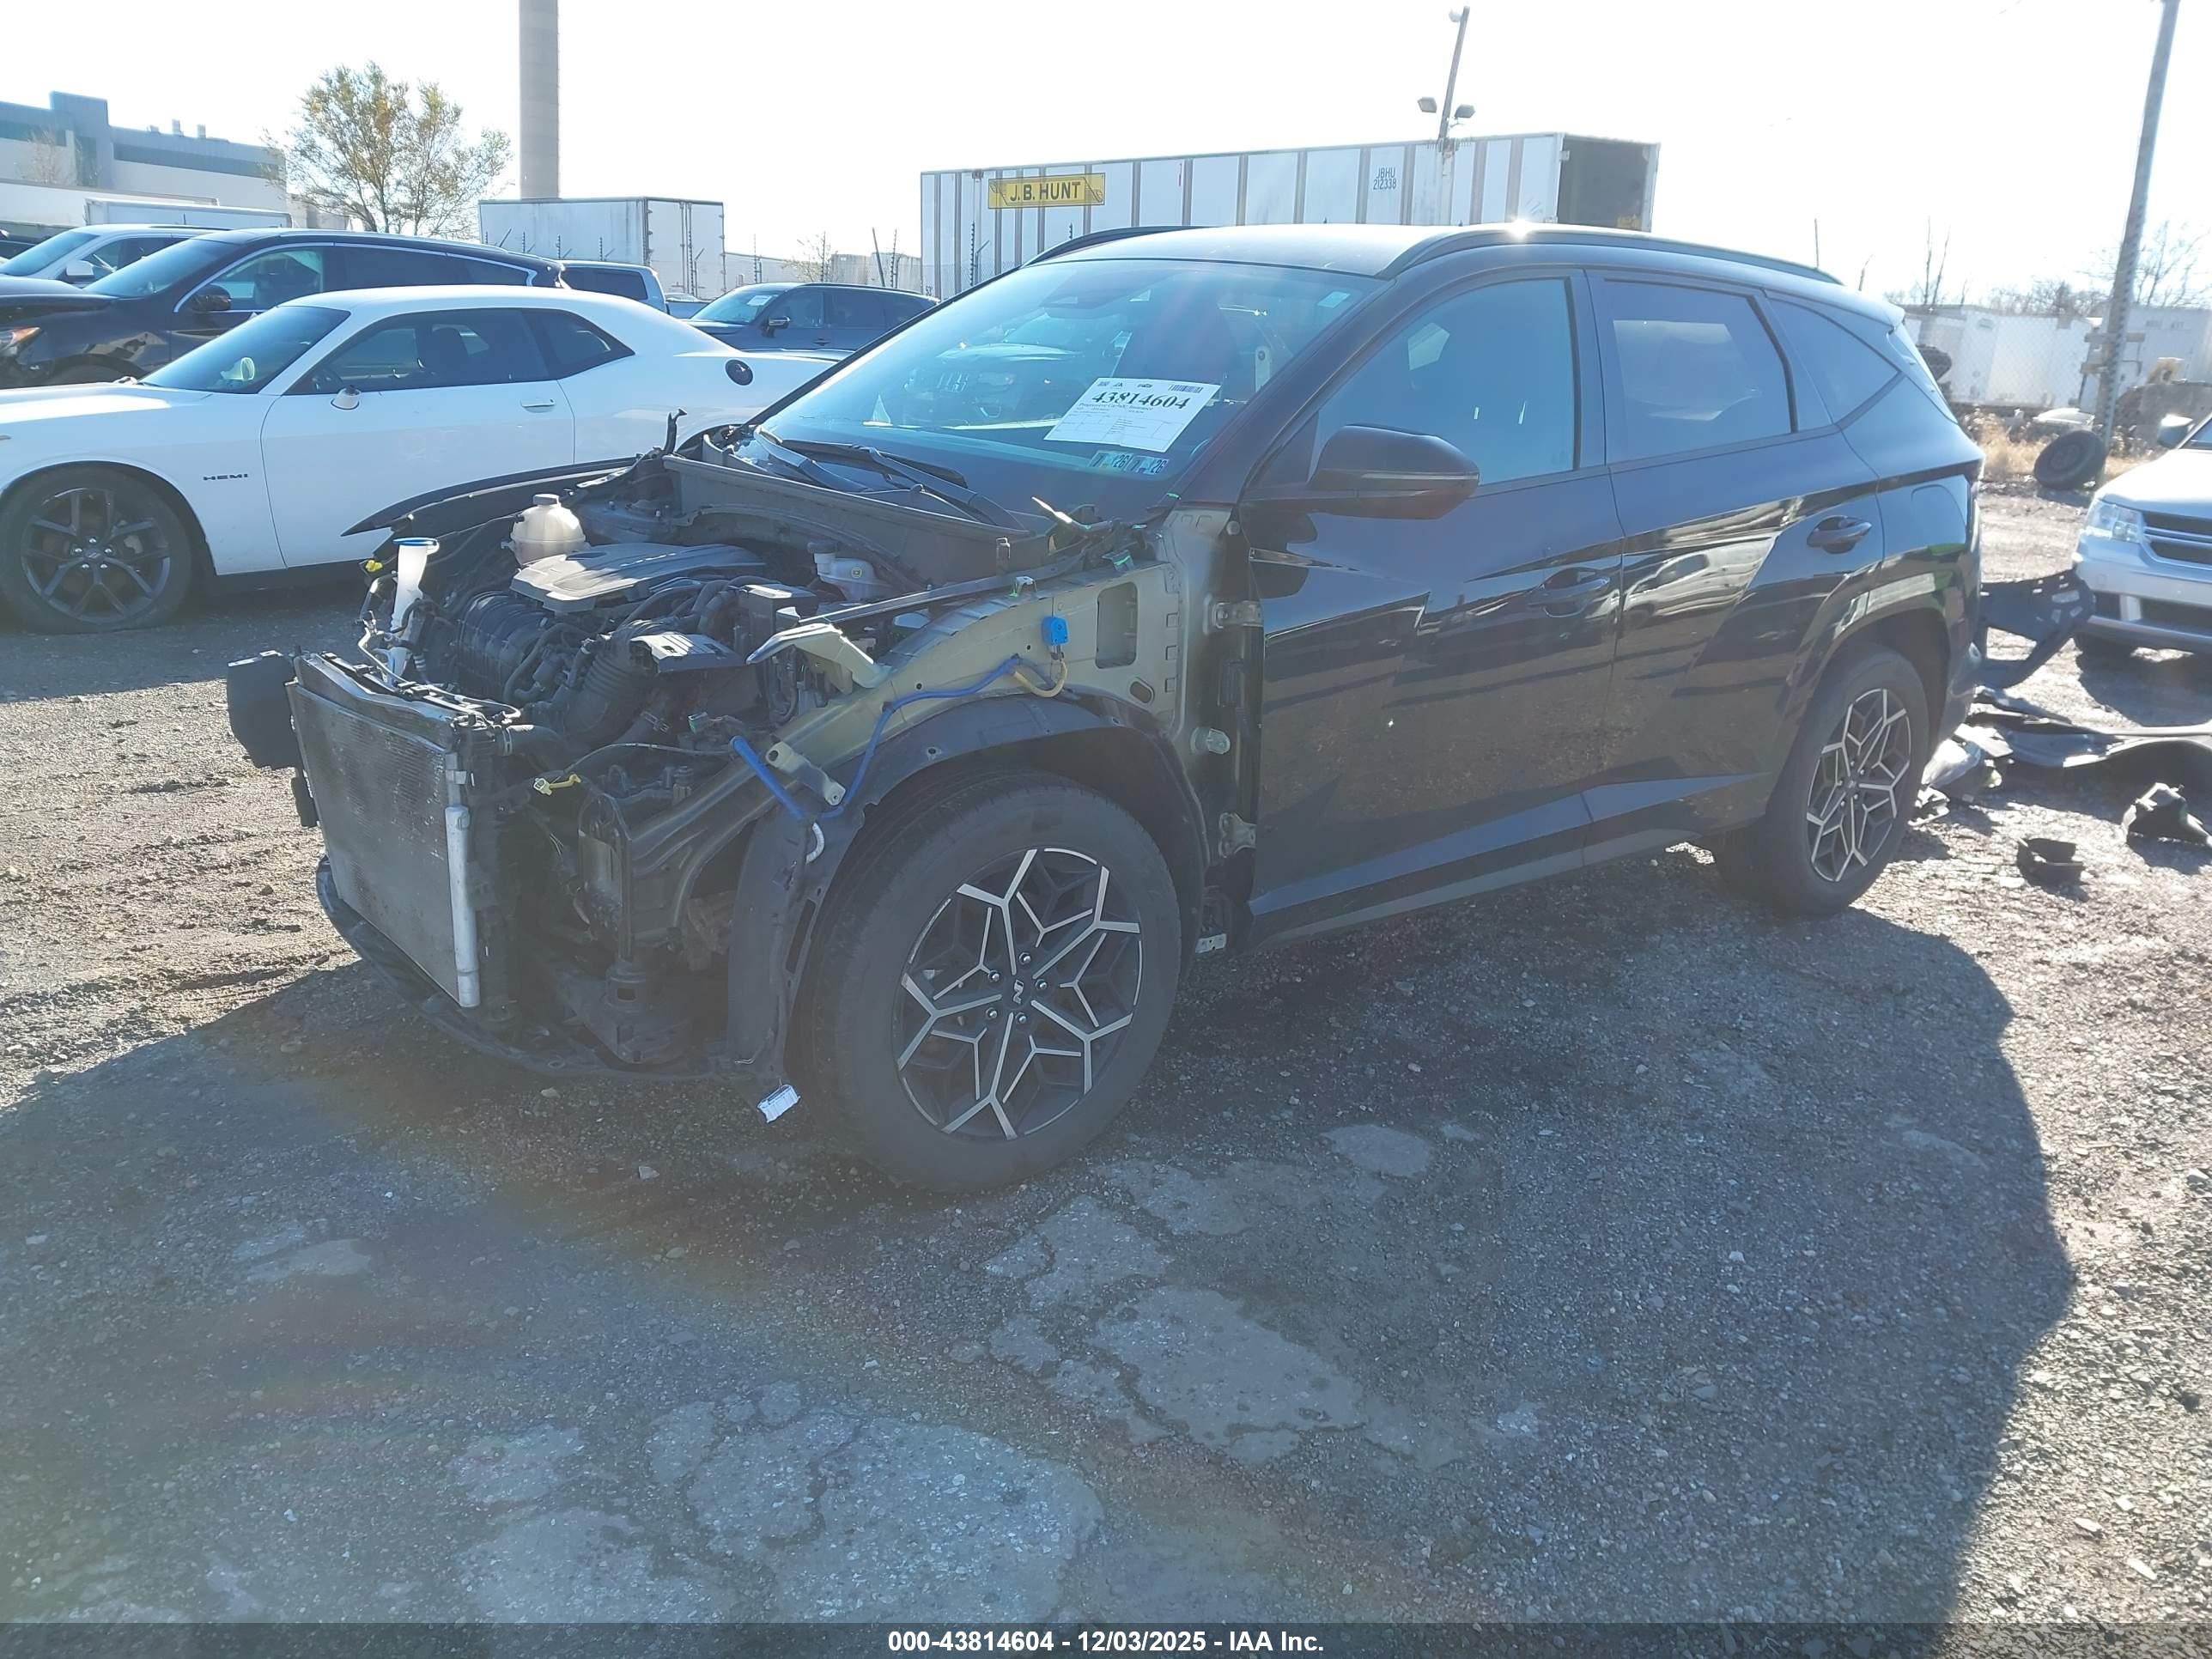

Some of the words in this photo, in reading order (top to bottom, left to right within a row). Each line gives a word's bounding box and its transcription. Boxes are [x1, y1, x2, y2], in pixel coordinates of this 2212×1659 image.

[1376, 167, 1396, 179] JBHU
[1010, 184, 1036, 202] J.B.
[1039, 181, 1081, 200] HUNT
[1373, 178, 1397, 190] 212338
[1091, 391, 1192, 410] 43814604
